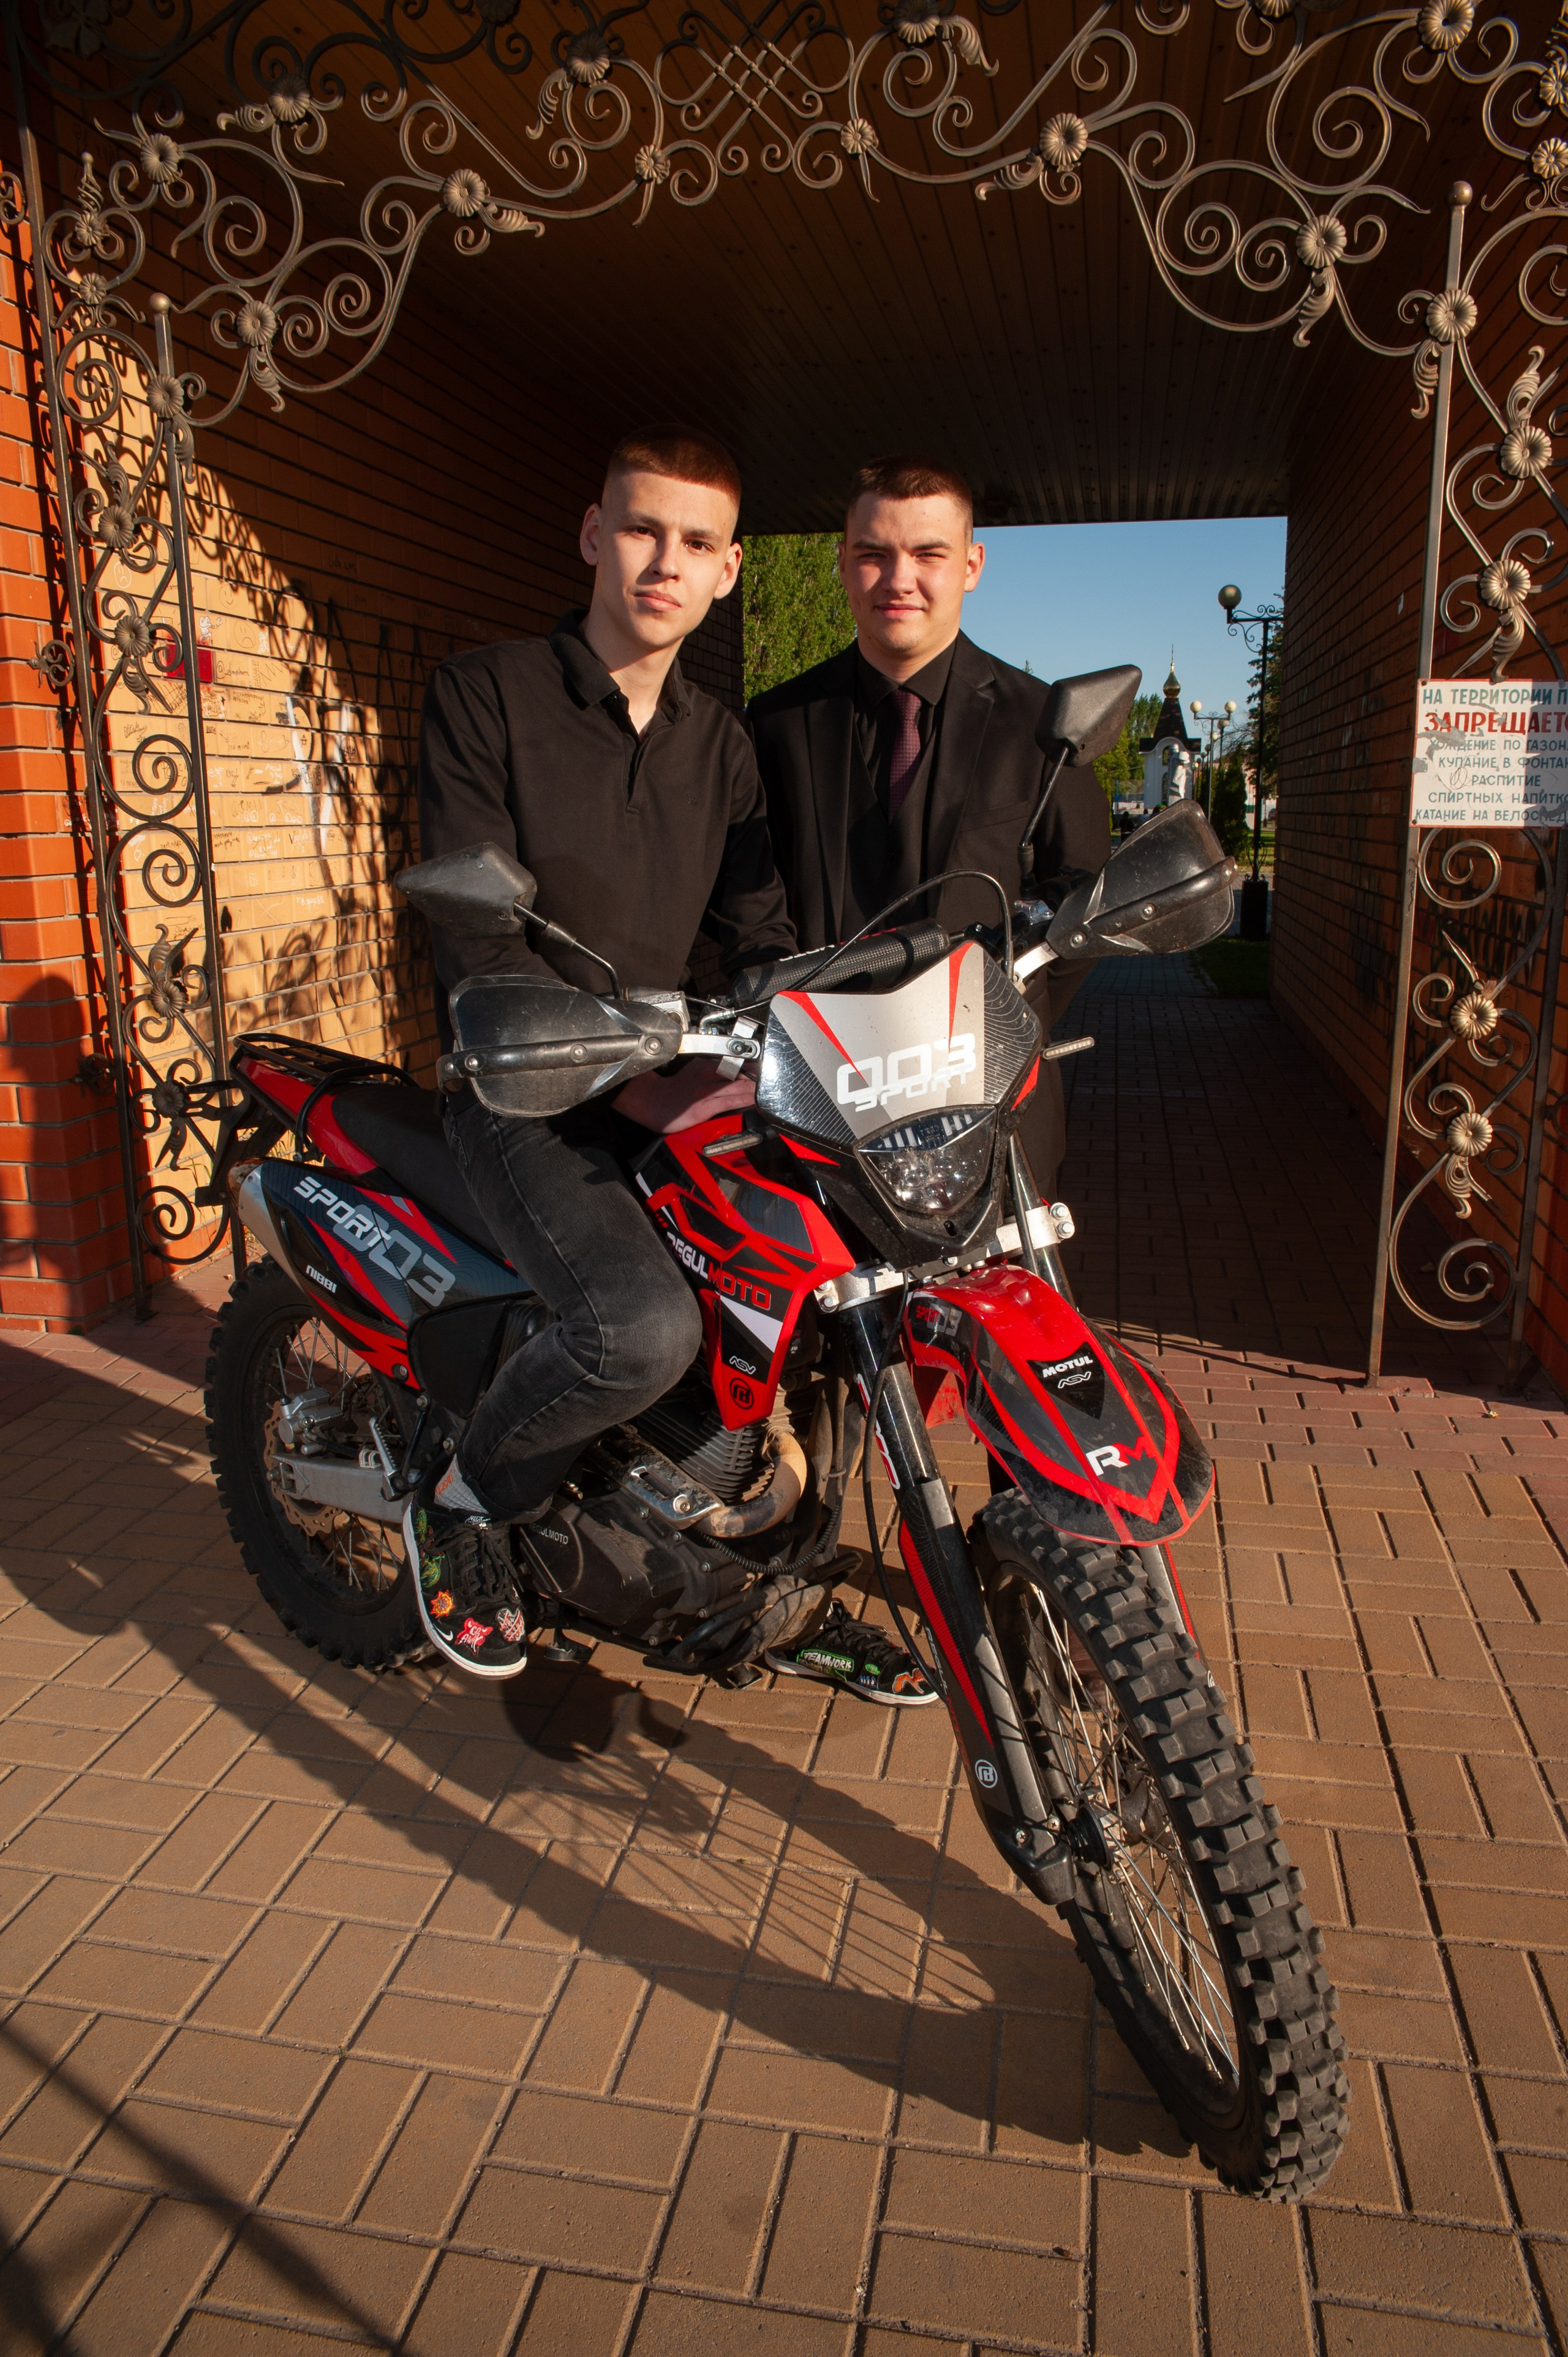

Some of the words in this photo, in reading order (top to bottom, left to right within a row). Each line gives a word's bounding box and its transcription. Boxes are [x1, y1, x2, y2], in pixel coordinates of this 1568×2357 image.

[1423, 689, 1442, 704] НА
[1450, 689, 1552, 705] ТЕРРИТОРИИ
[1558, 689, 1568, 705] П
[1430, 739, 1496, 752] ХОДЕНИЕ
[1504, 740, 1520, 750] ПО
[1526, 740, 1568, 751] ГАЗОН
[1439, 757, 1497, 768] КУПАНИЕ
[1503, 757, 1511, 768] В
[1472, 775, 1541, 786] РАСПИТИЕ
[1428, 792, 1503, 803] СПИРТНЫХ
[1415, 809, 1466, 820] КАТАНИЕ
[1473, 810, 1488, 820] НА
[1495, 810, 1567, 823] ВЕЛОСД
[837, 1033, 975, 1104] 003
[855, 1064, 973, 1112] SPORT
[293, 1176, 391, 1248] SPORT
[333, 1205, 456, 1307] 003
[1042, 1356, 1093, 1378] MOTUL
[803, 1652, 852, 1670] TEAMWORK
